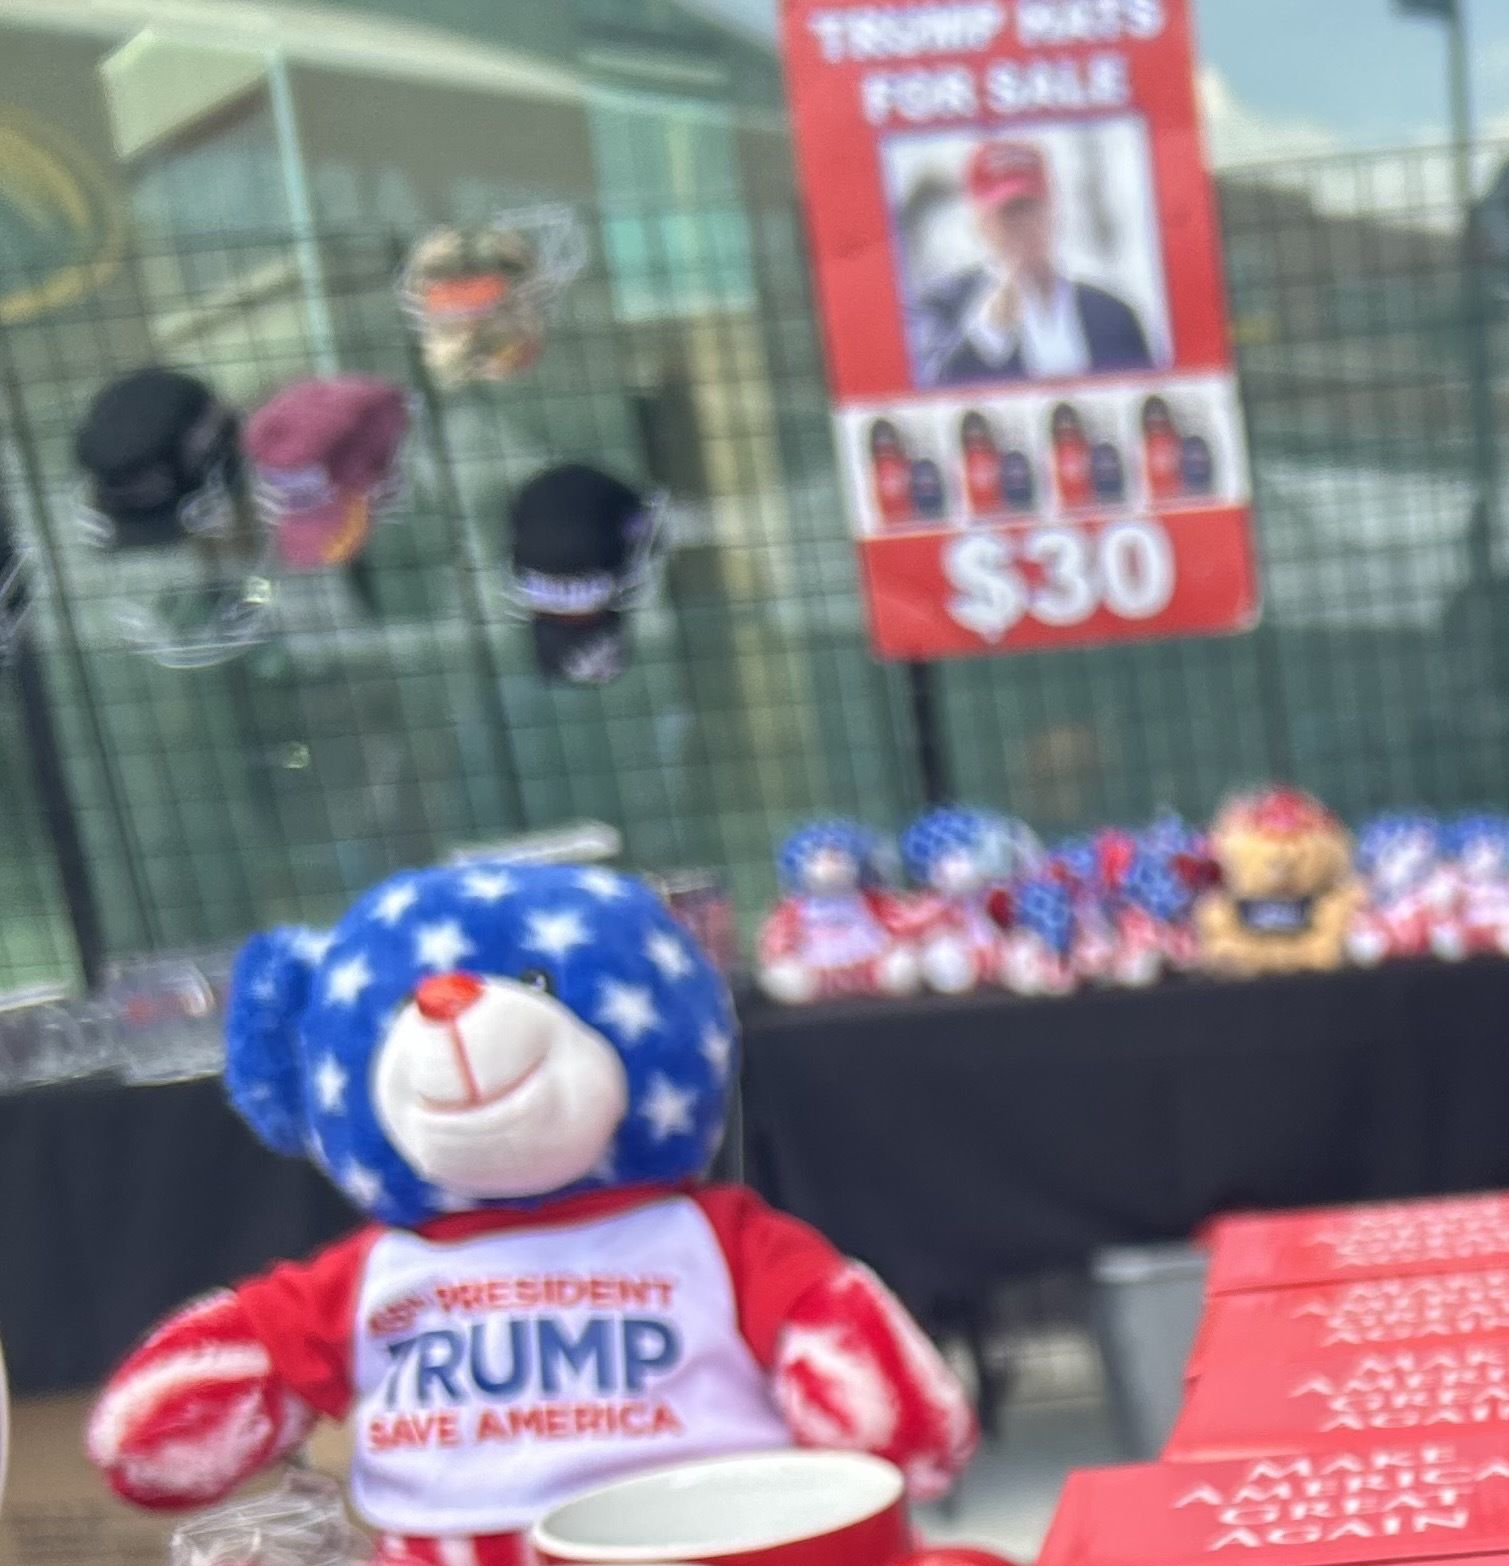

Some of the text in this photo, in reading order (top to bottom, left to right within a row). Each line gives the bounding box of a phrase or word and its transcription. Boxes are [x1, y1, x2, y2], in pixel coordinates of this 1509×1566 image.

[860, 53, 1129, 125] FOR SALE
[942, 520, 1175, 642] $30
[436, 1276, 674, 1313] PRESIDENT
[388, 1317, 680, 1411] TRUMP
[369, 1402, 683, 1450] SAVE AMERICA
[1247, 1443, 1455, 1482] MAKE
[1218, 1484, 1472, 1526] GREAT
[1208, 1507, 1469, 1552] AGAIN
